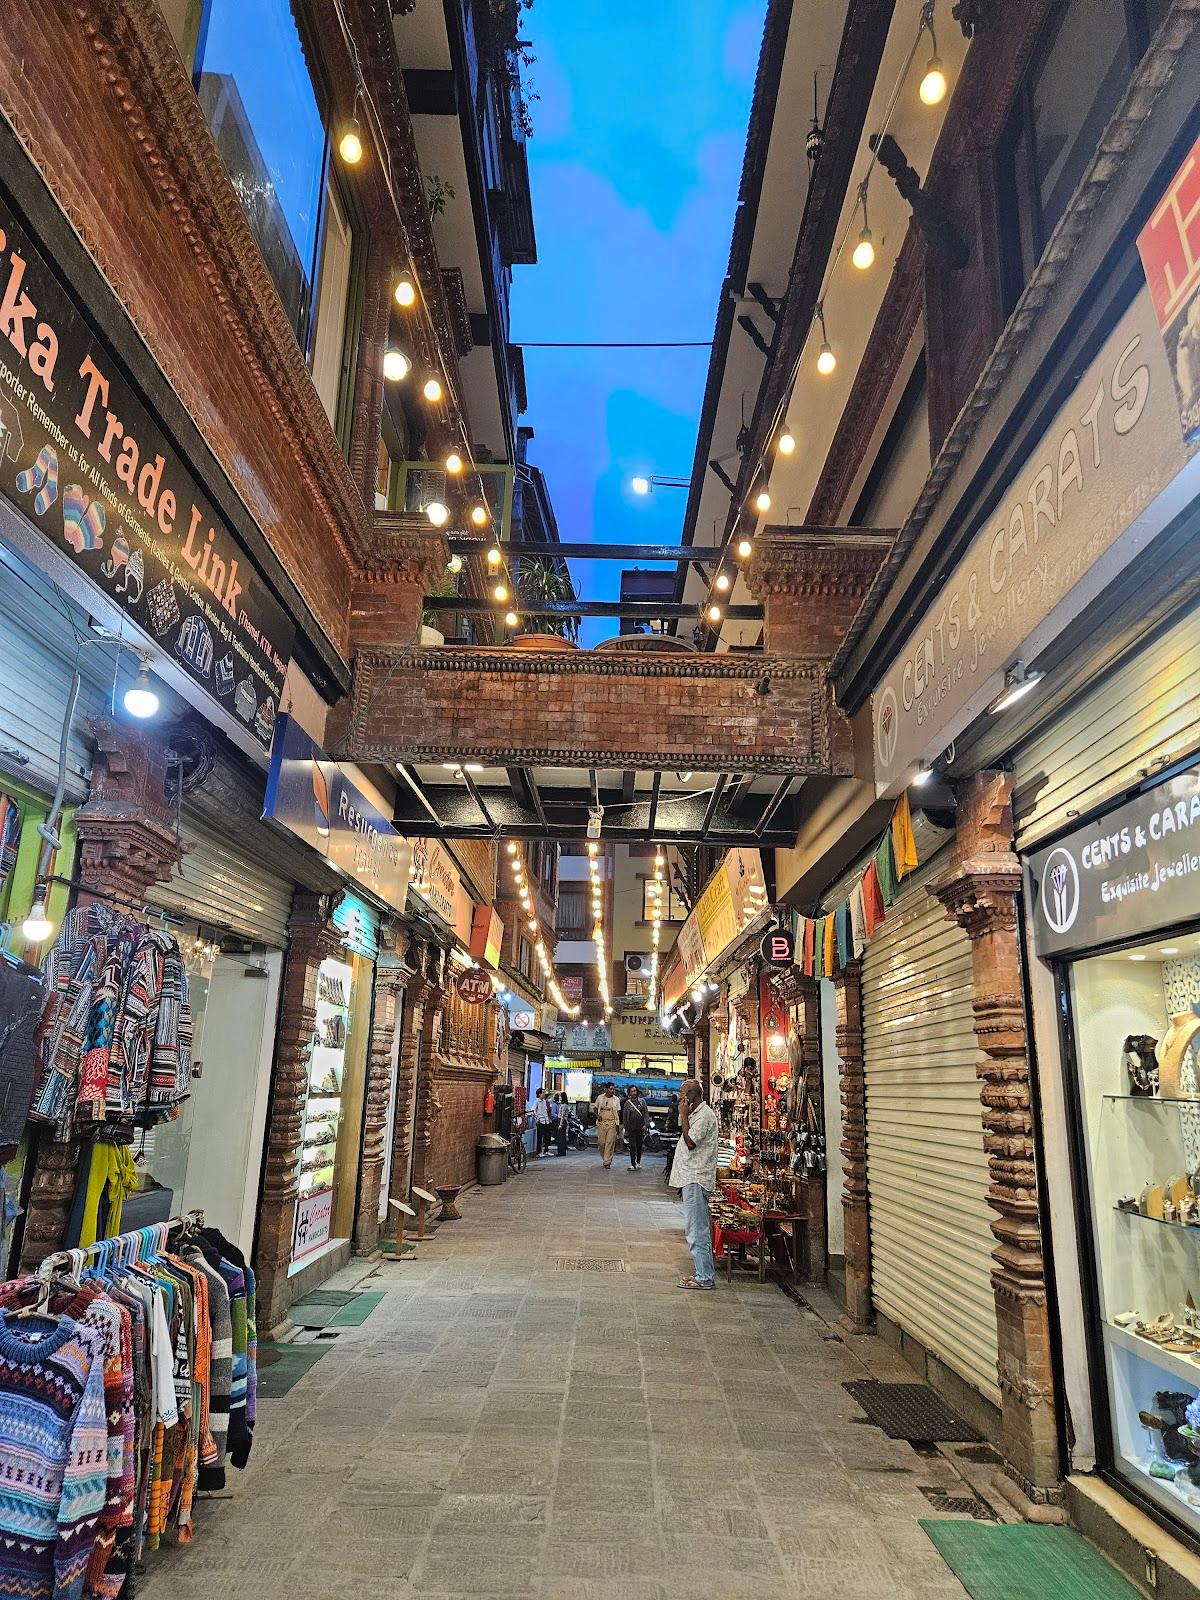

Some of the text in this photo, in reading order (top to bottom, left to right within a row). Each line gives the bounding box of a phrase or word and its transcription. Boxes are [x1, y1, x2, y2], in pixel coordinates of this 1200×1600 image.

[26, 391, 69, 450] Remember
[68, 444, 79, 462] us
[79, 451, 90, 475] for
[88, 466, 101, 487] All
[98, 478, 118, 507] Kinds
[117, 500, 126, 515] of
[124, 508, 152, 547] Garments
[74, 354, 177, 534] Trade
[181, 504, 243, 620] Link
[902, 334, 1151, 712] CENTS & CARATS
[916, 551, 1050, 727] Exquisite Jewellery
[1081, 827, 1131, 869] CENTS
[1135, 825, 1147, 848] &
[1101, 872, 1150, 903] Exquisite
[460, 978, 490, 994] ATM
